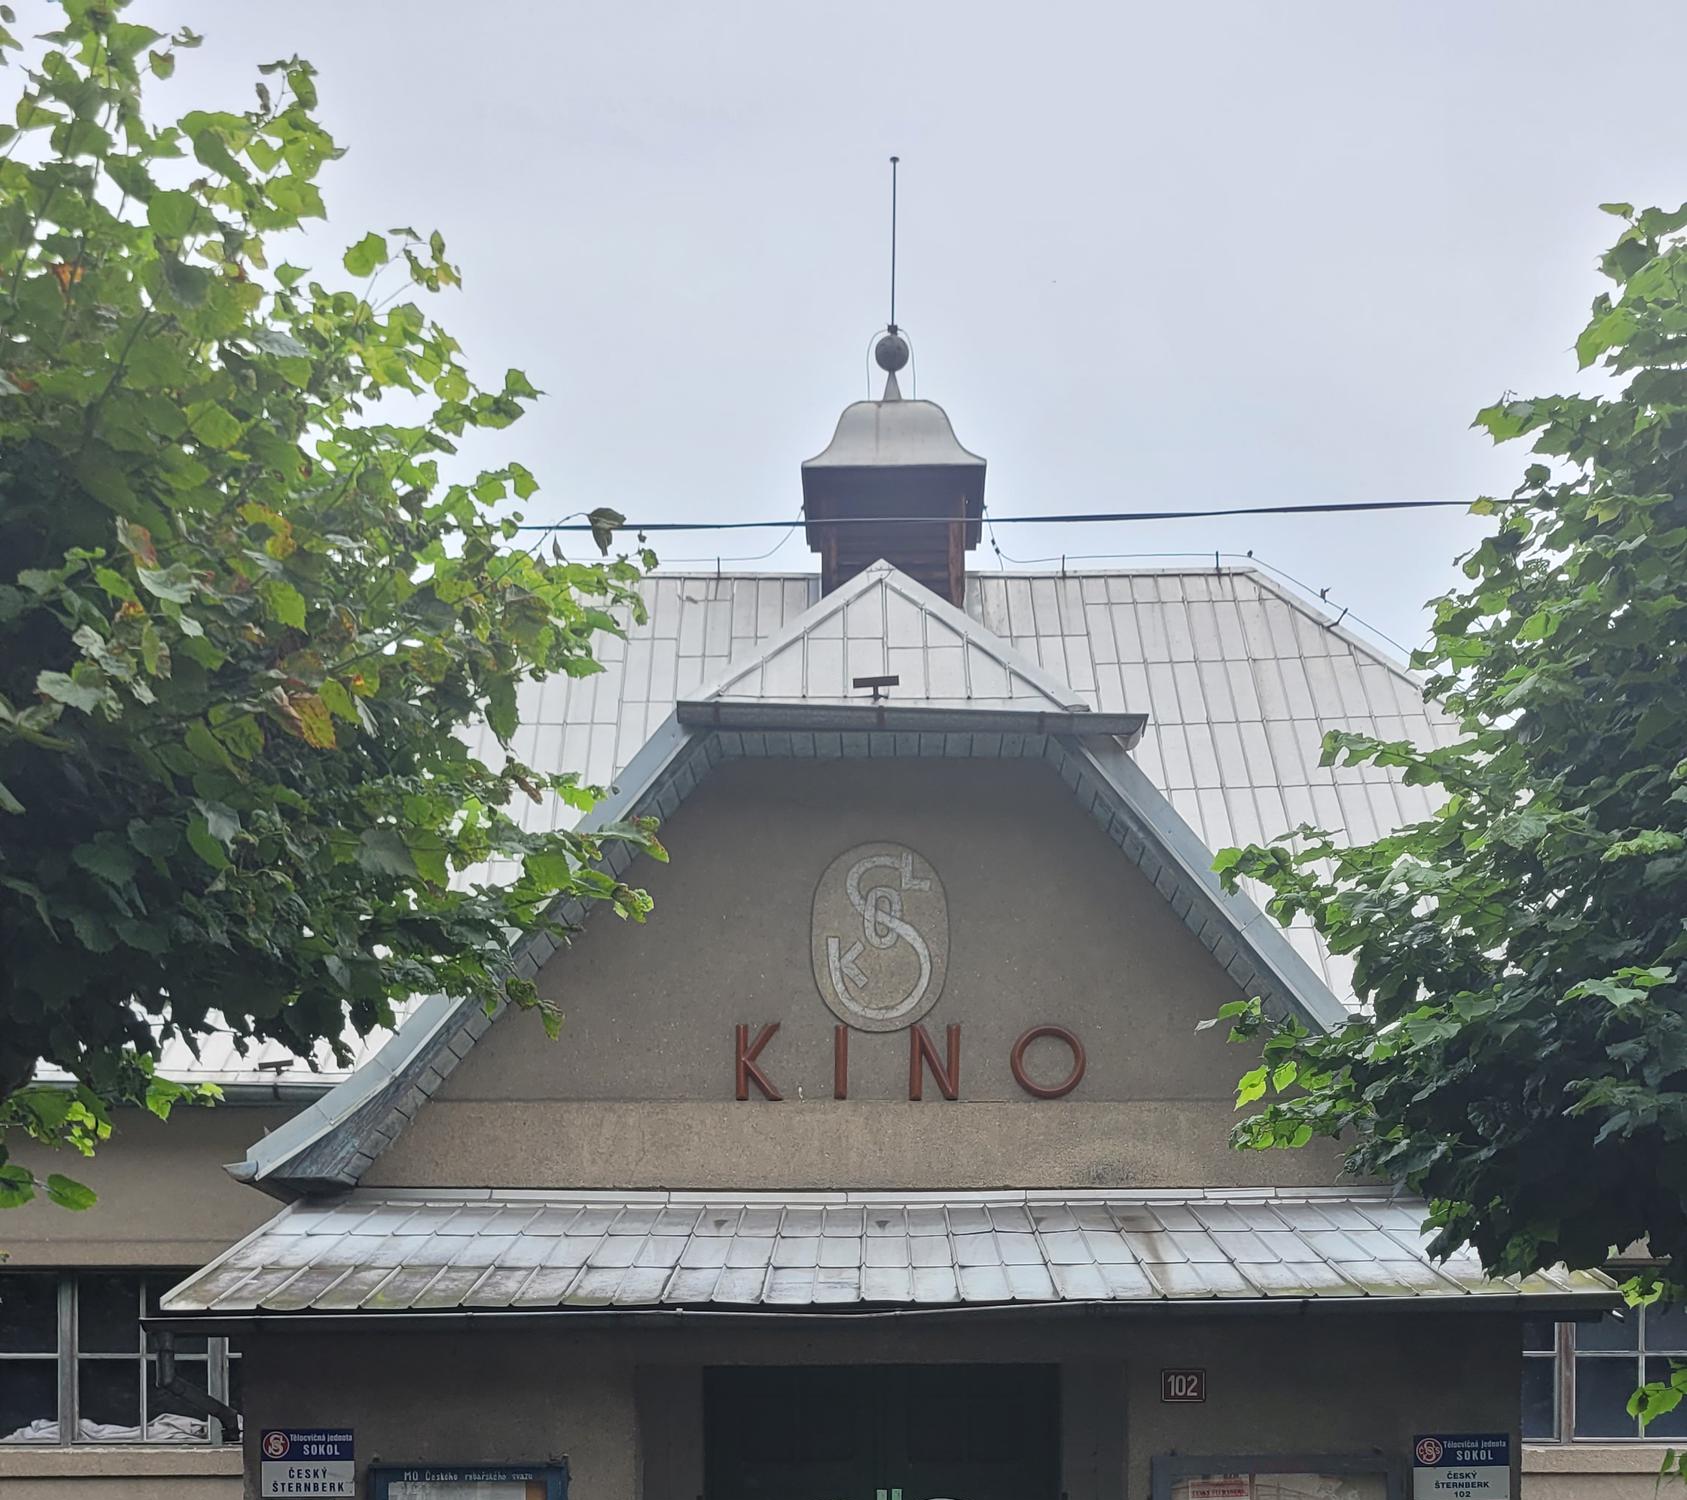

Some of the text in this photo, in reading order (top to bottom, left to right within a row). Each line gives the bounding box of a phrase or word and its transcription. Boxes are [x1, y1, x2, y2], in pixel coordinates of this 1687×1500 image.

[735, 1021, 1087, 1101] KINO
[1167, 1374, 1198, 1397] 102
[327, 1433, 353, 1442] jednota
[1481, 1440, 1507, 1449] jednota
[303, 1444, 340, 1456] SOKOL
[1456, 1450, 1494, 1461] SOKOL
[288, 1466, 328, 1479] ČESKÝ
[404, 1471, 418, 1481] MO
[1446, 1470, 1478, 1480] ČESKÝ
[272, 1480, 345, 1493] ŠTERNBERK
[1434, 1480, 1490, 1489] ŠTERNBERK
[1454, 1490, 1472, 1498] 102
